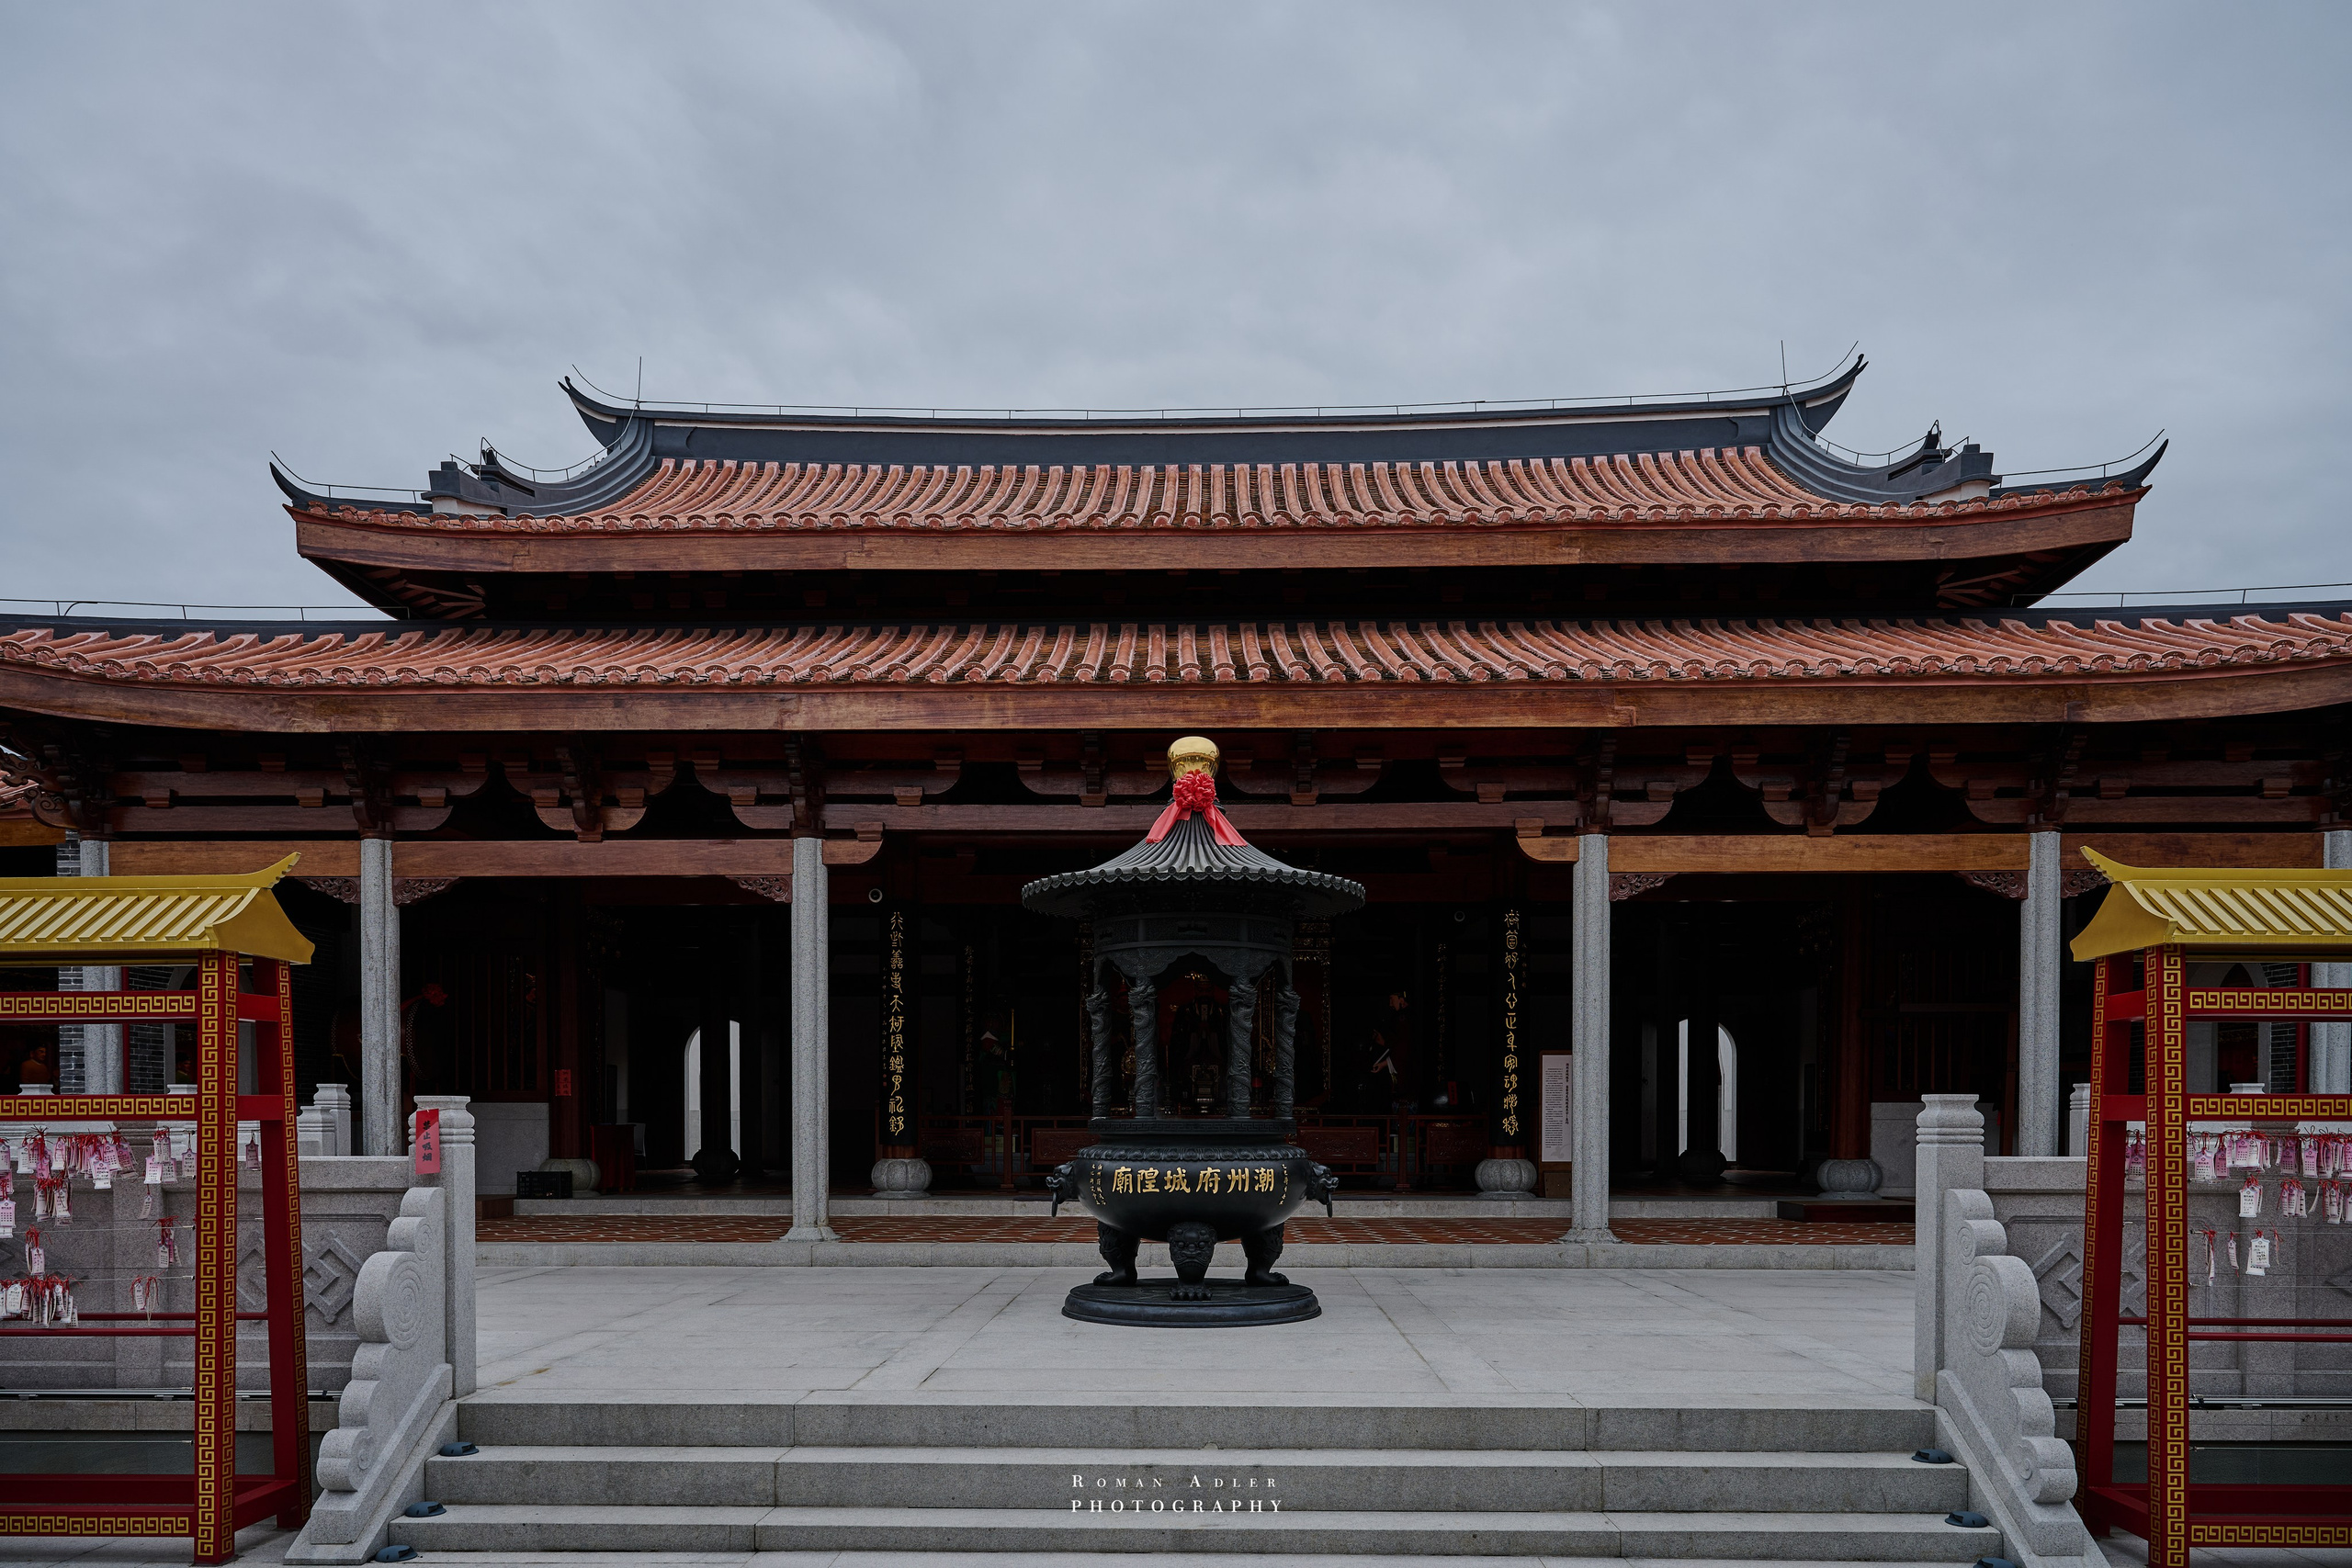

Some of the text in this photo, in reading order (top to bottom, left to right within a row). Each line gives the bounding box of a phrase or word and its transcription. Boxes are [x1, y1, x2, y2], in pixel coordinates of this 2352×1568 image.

[1112, 1166, 1275, 1194] 潮州府城隍廟
